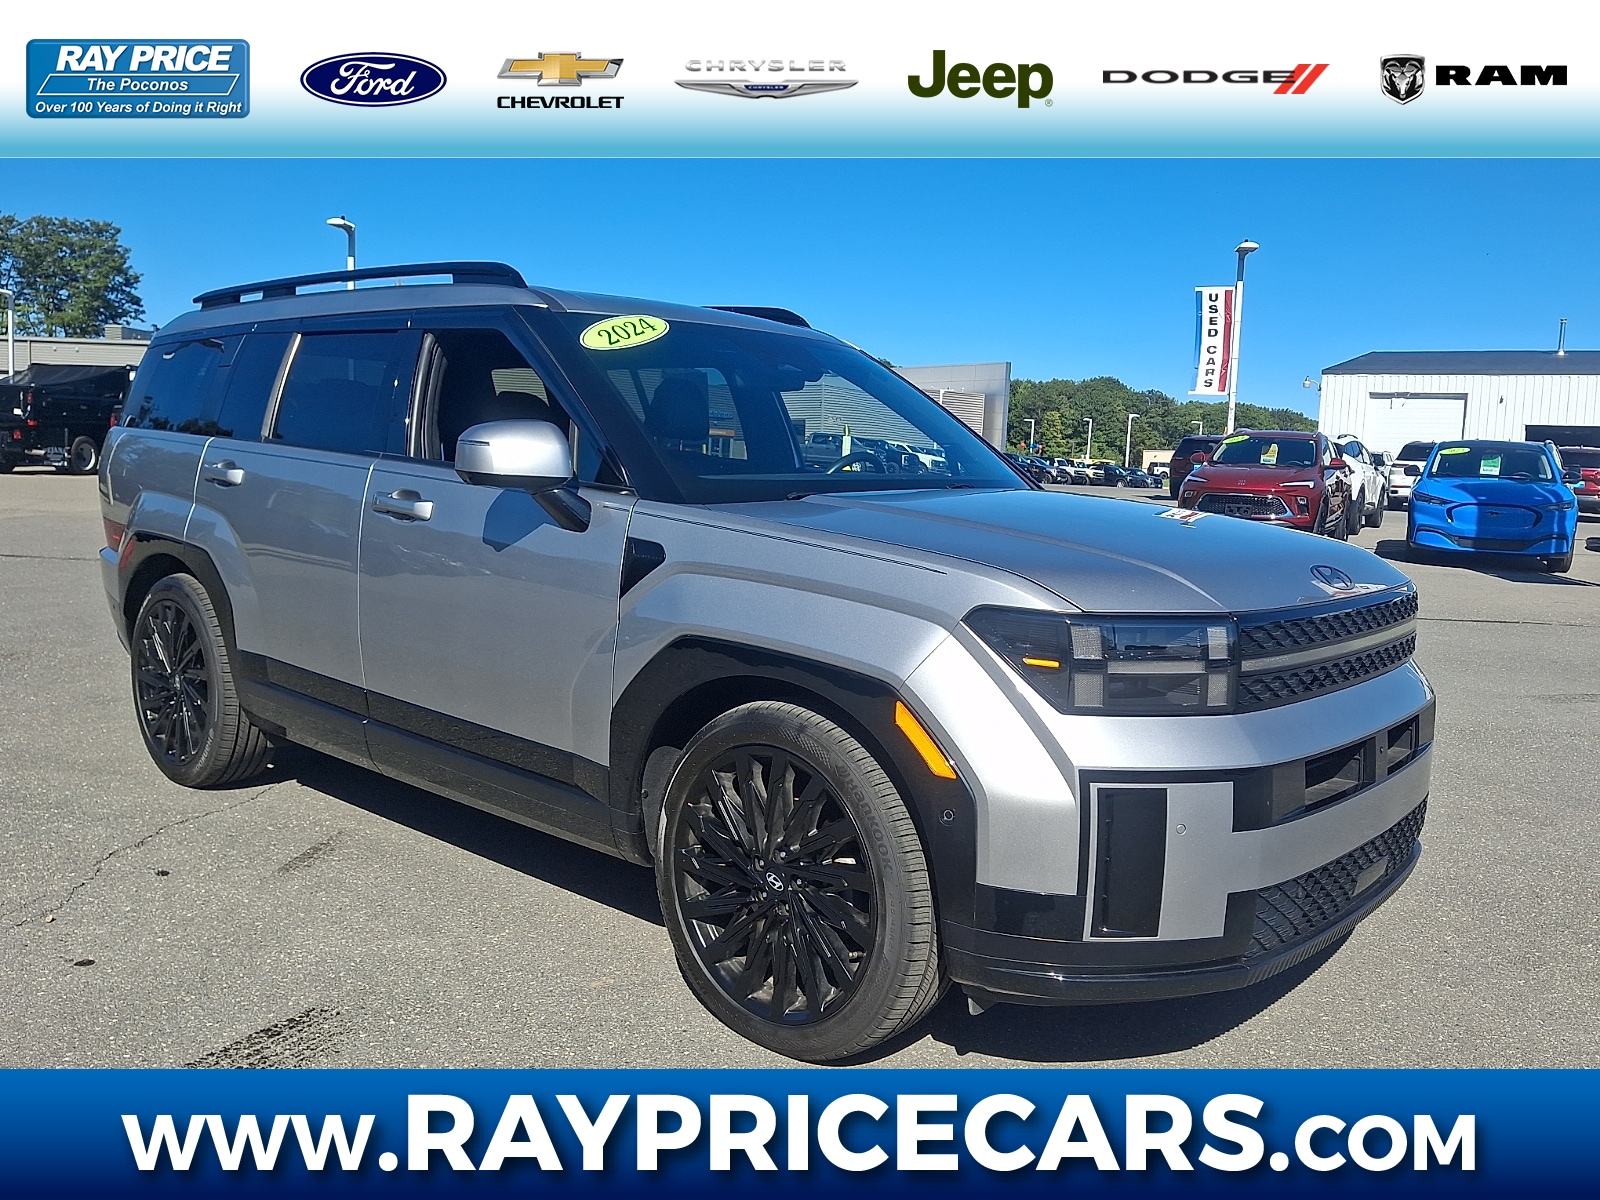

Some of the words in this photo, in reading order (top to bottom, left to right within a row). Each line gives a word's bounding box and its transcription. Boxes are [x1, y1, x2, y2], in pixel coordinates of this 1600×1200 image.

[597, 317, 658, 346] 2024
[1207, 293, 1219, 338] USED
[1203, 345, 1218, 388] CARS
